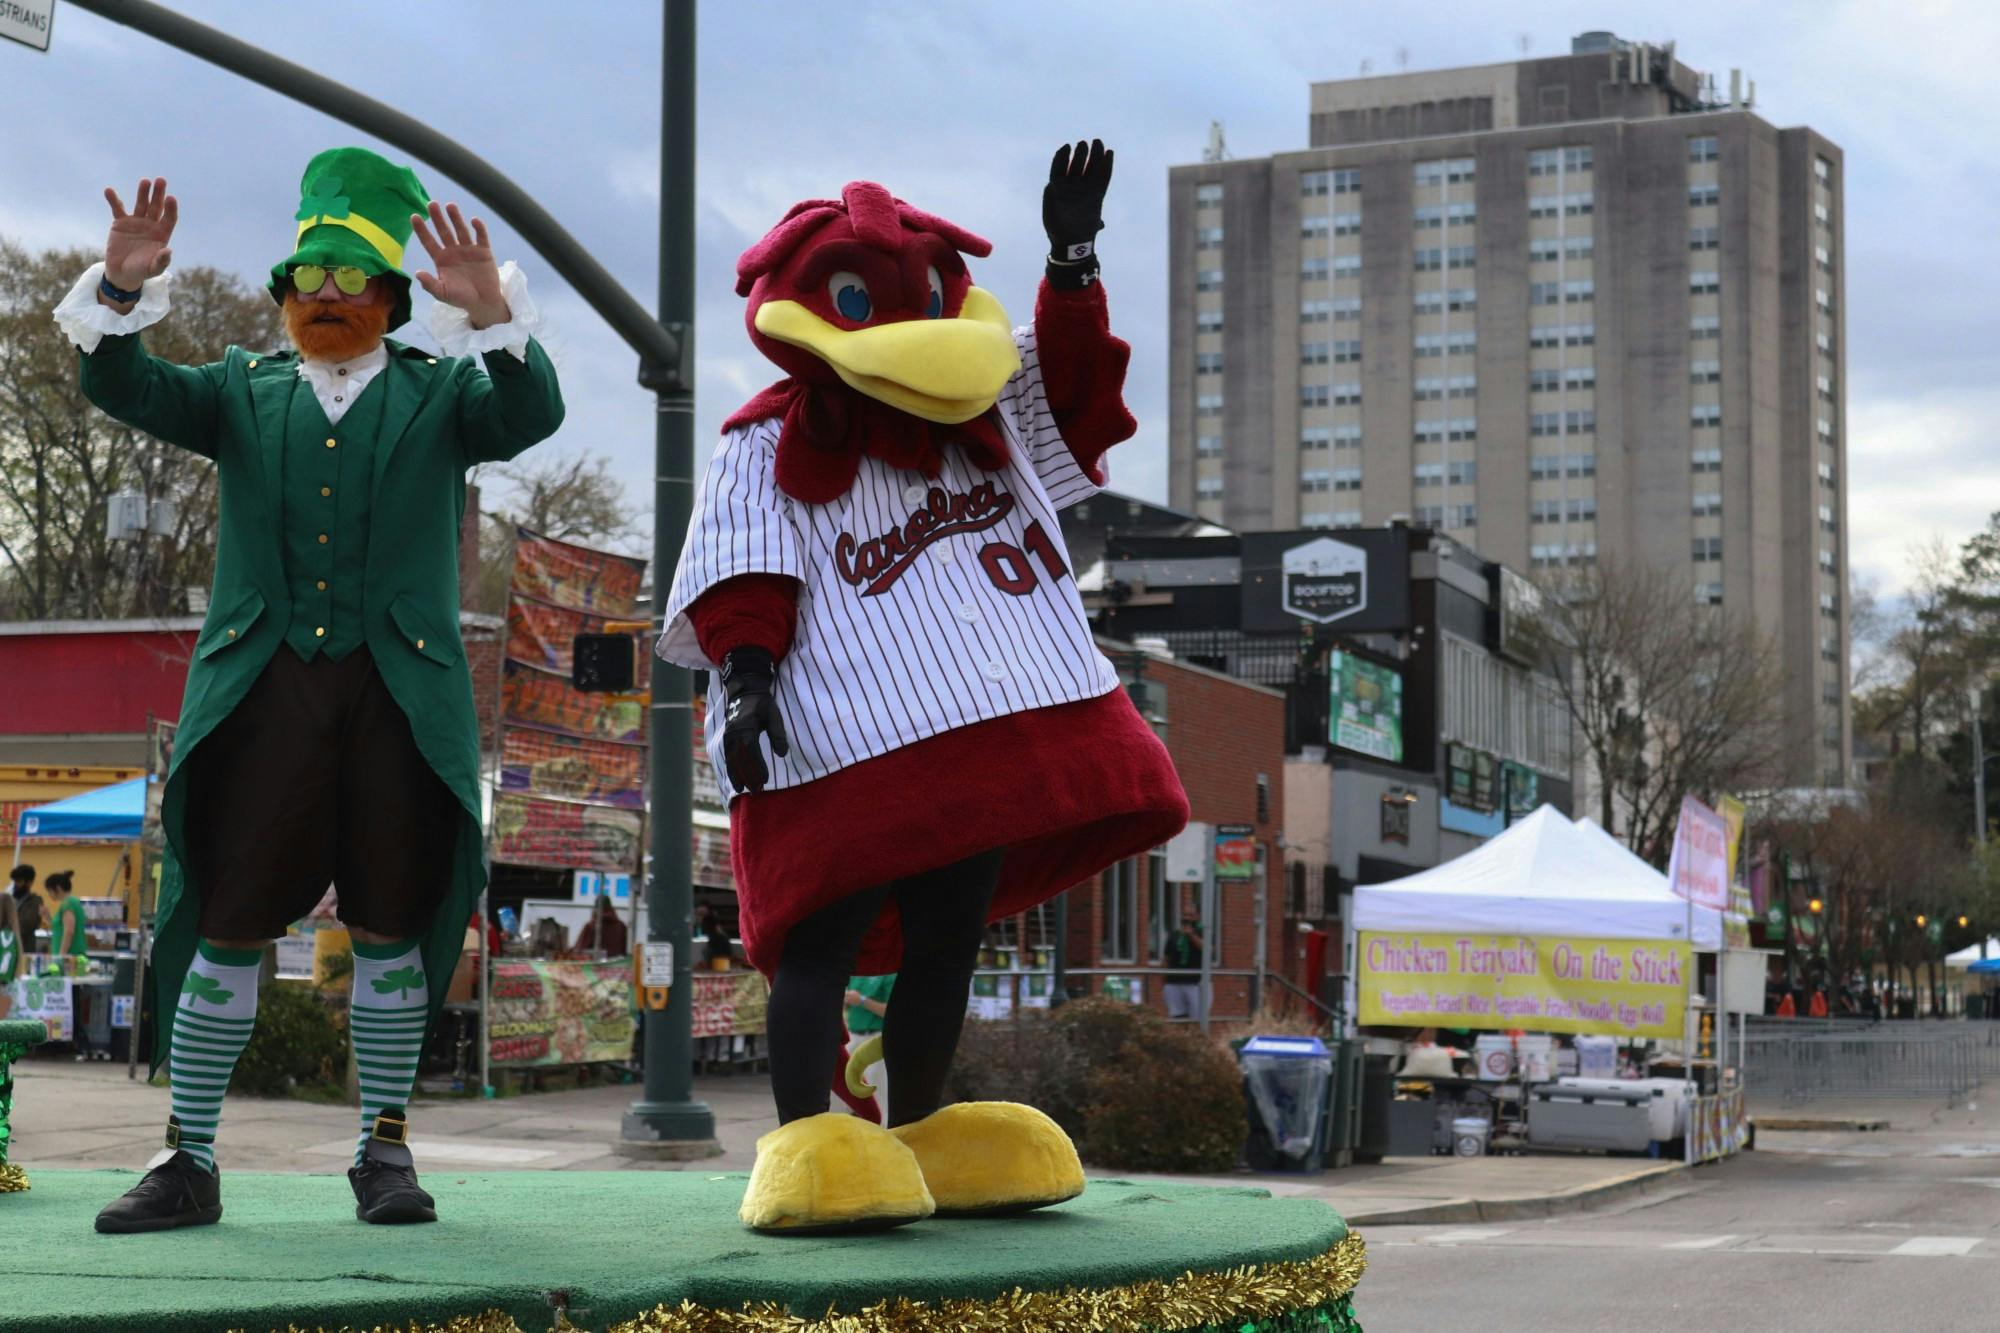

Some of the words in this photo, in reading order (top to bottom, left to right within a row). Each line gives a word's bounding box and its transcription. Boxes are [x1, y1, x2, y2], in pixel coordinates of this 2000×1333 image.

[978, 518, 1069, 596] 01
[1294, 584, 1355, 597] ROOFTOP
[1367, 938, 1447, 973] Chicken
[1456, 939, 1536, 984] Teriyaki
[1552, 943, 1582, 978] On
[1591, 947, 1622, 981] the
[1630, 947, 1682, 985] Stick
